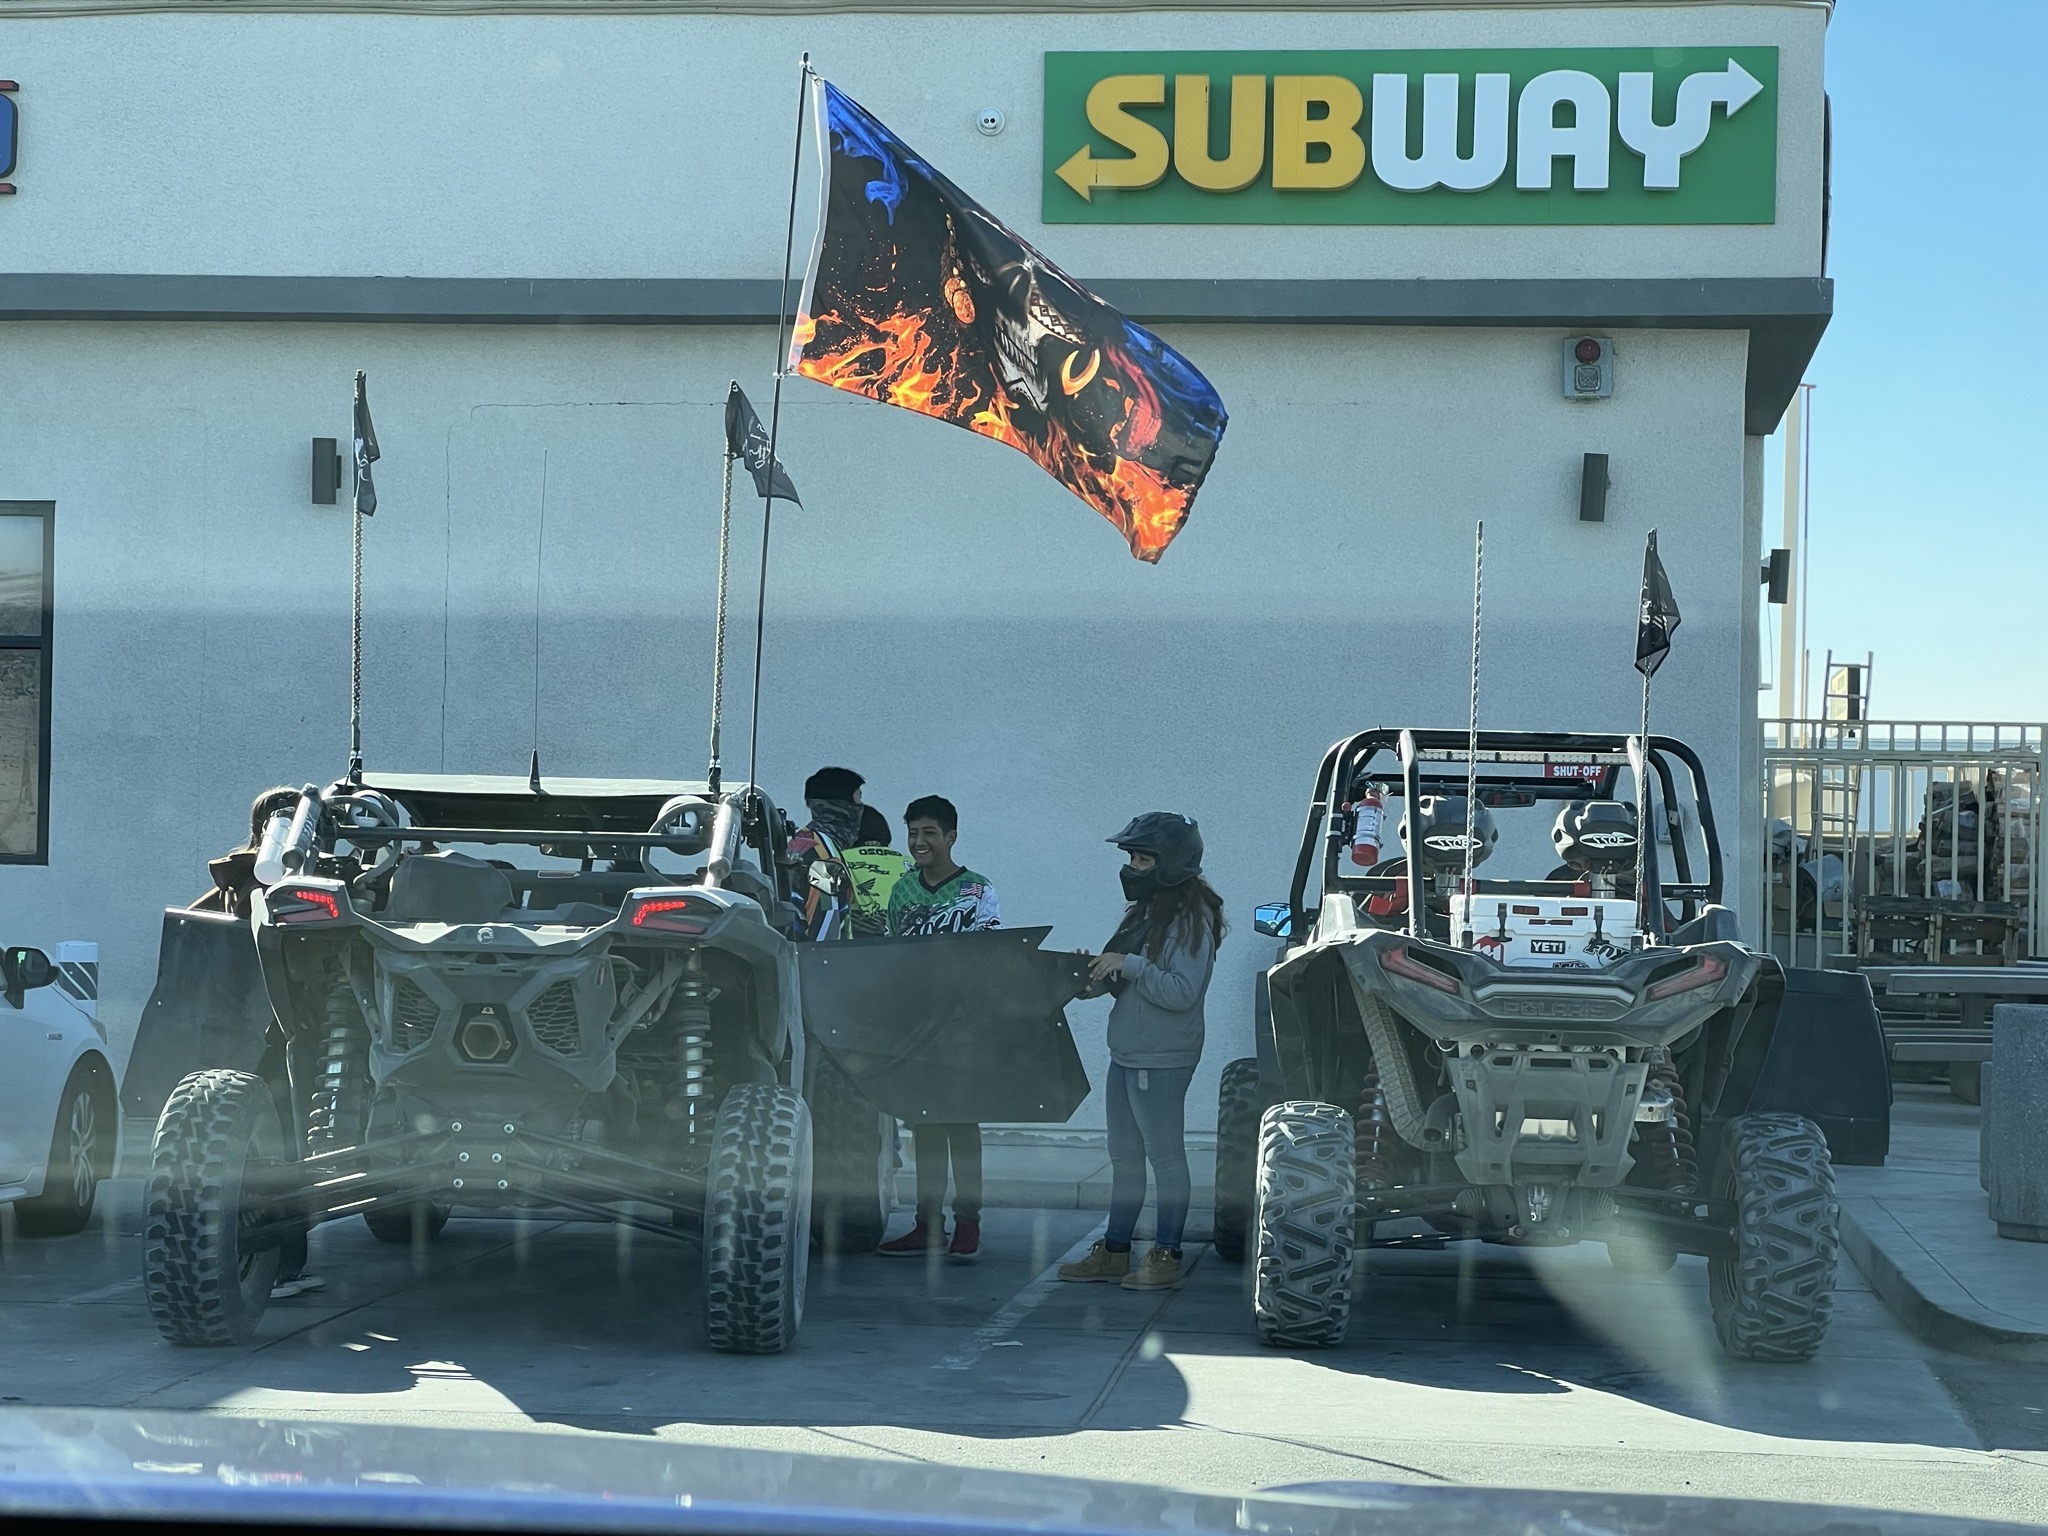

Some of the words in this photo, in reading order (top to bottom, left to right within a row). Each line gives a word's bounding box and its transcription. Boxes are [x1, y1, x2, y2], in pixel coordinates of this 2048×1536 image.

[1054, 57, 1764, 202] SUBWAY
[1553, 765, 1601, 777] SHUT-OFF
[1593, 835, 1624, 845] BOSS
[1532, 941, 1563, 952] YETI
[1504, 1001, 1606, 1017] POLARIS
